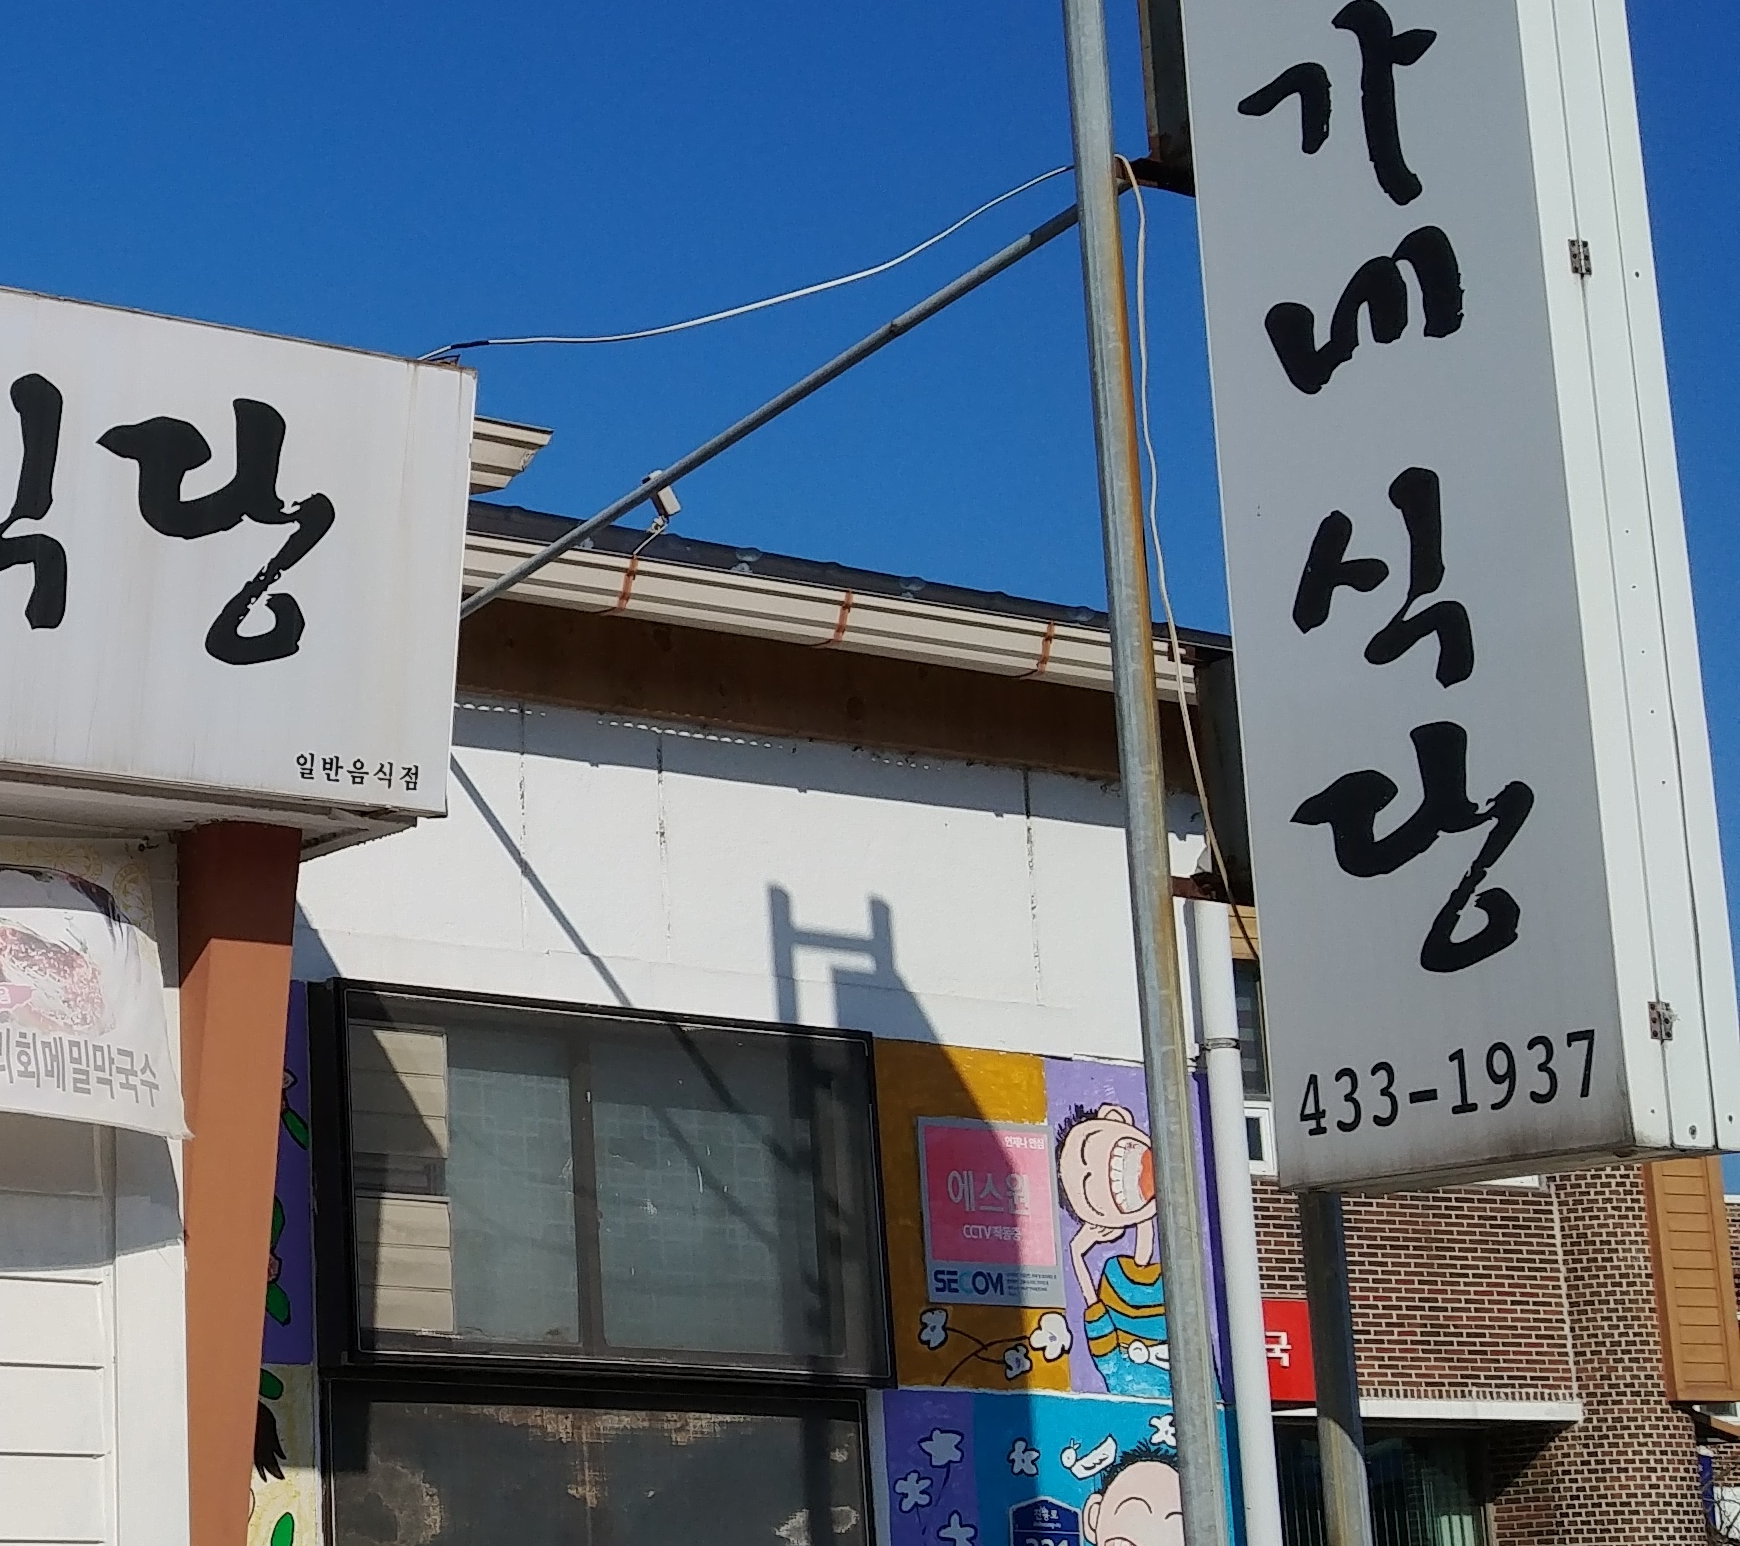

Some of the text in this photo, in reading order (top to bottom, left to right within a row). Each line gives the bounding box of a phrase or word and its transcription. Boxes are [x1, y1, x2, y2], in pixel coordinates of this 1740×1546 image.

[1290, 466, 1535, 974] 식당
[296, 752, 420, 792] 일반음식점
[1299, 1028, 1597, 1137] 433-1937
[947, 1170, 1031, 1217] 에스원
[933, 1269, 1005, 1296] SECOM
